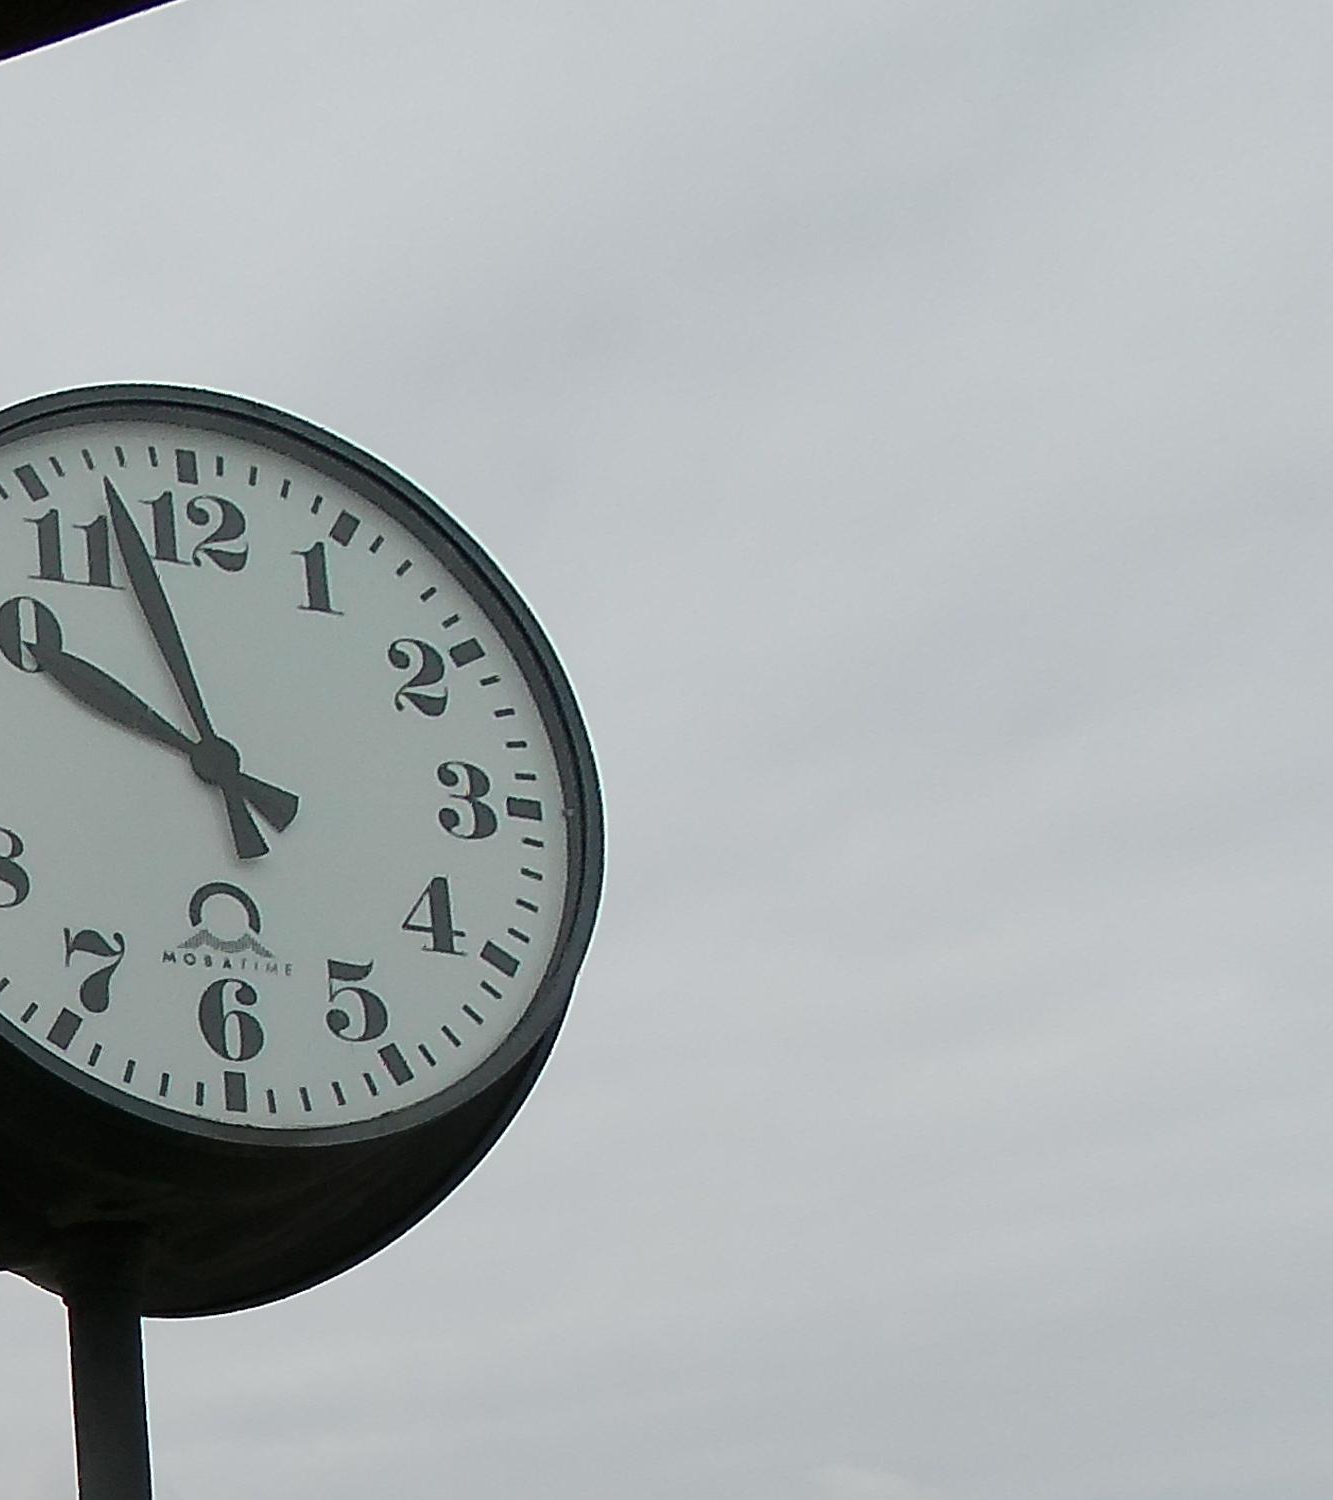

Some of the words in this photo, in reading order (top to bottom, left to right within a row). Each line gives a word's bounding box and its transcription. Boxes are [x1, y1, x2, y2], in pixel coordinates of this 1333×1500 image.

[23, 508, 126, 590] 11
[138, 490, 250, 571] 12
[291, 541, 344, 615] 1
[387, 638, 448, 717] 2
[437, 761, 498, 840] 3
[402, 876, 466, 956] 4
[64, 927, 125, 1013] 7
[162, 950, 294, 976] MOBATIME
[325, 959, 389, 1042] 5
[198, 979, 264, 1062] 6
